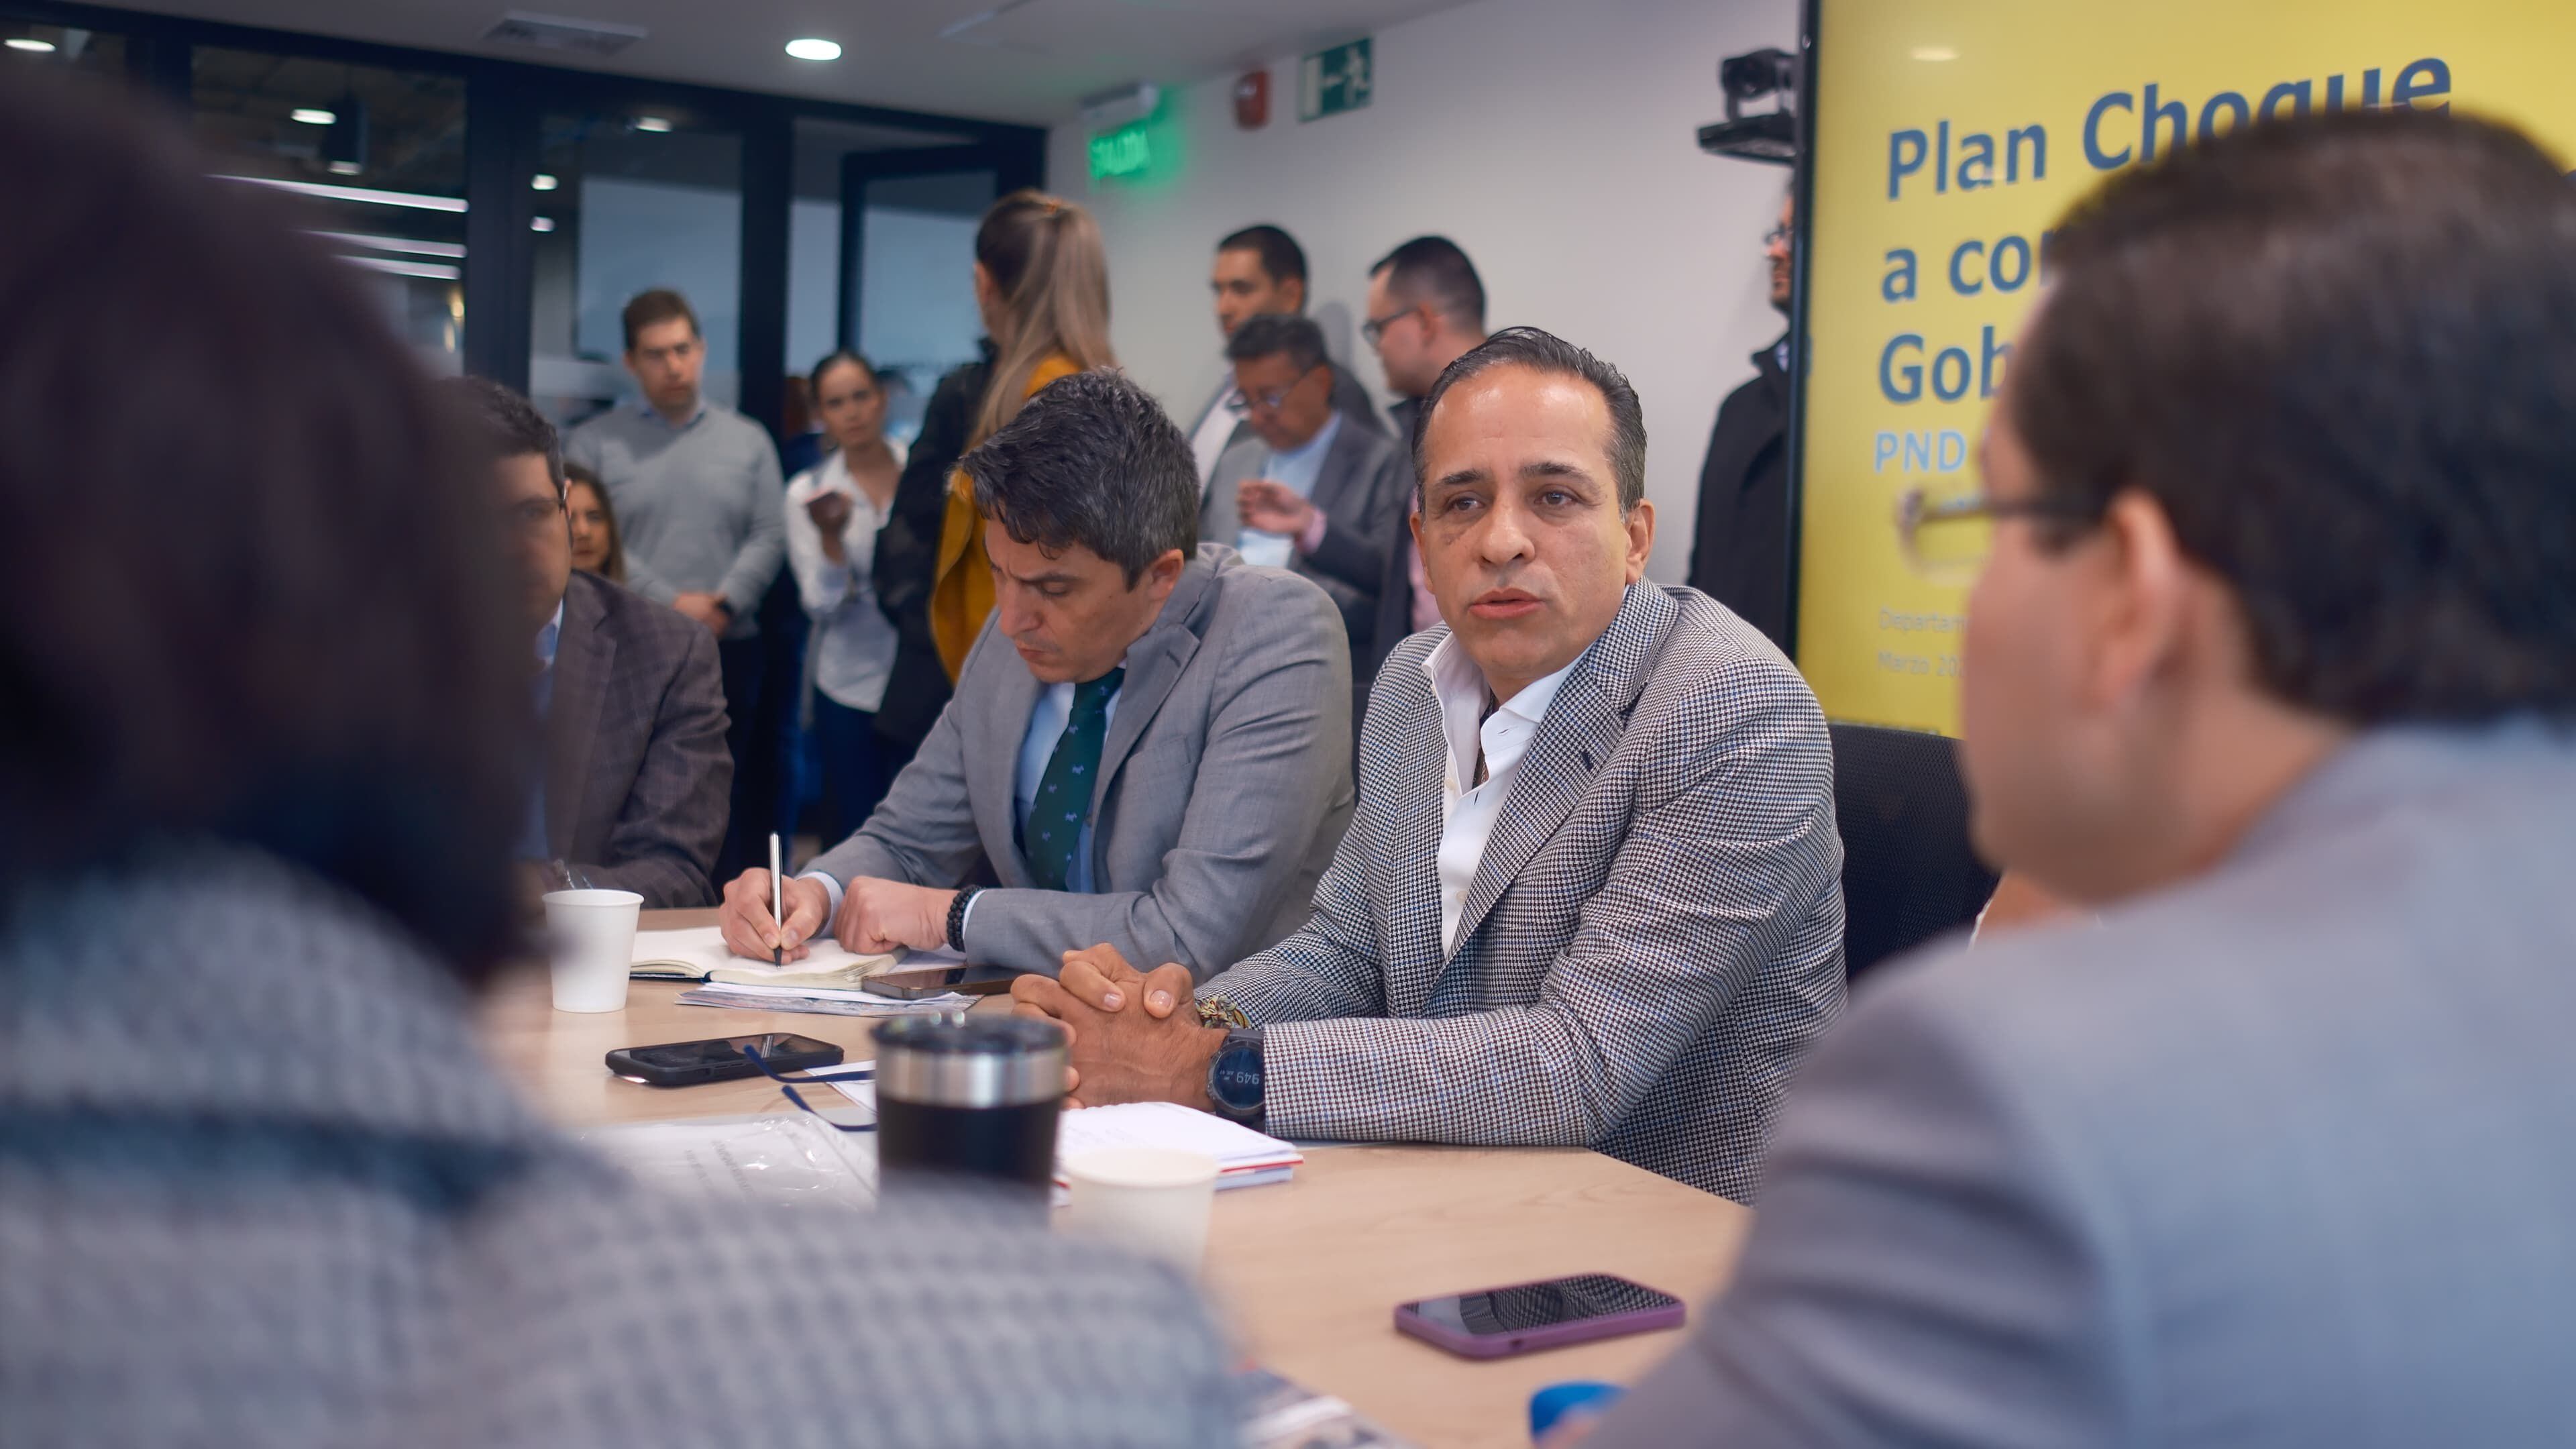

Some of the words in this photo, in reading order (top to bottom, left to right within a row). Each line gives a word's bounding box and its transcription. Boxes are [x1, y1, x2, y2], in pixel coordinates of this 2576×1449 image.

[1888, 120, 2046, 200] Plan
[1881, 247, 1917, 303] a
[1949, 230, 2057, 297] co
[1879, 323, 2015, 404] Gob
[1874, 429, 1967, 474] PND
[1879, 605, 1968, 635] Departam
[1937, 653, 1964, 678] 20
